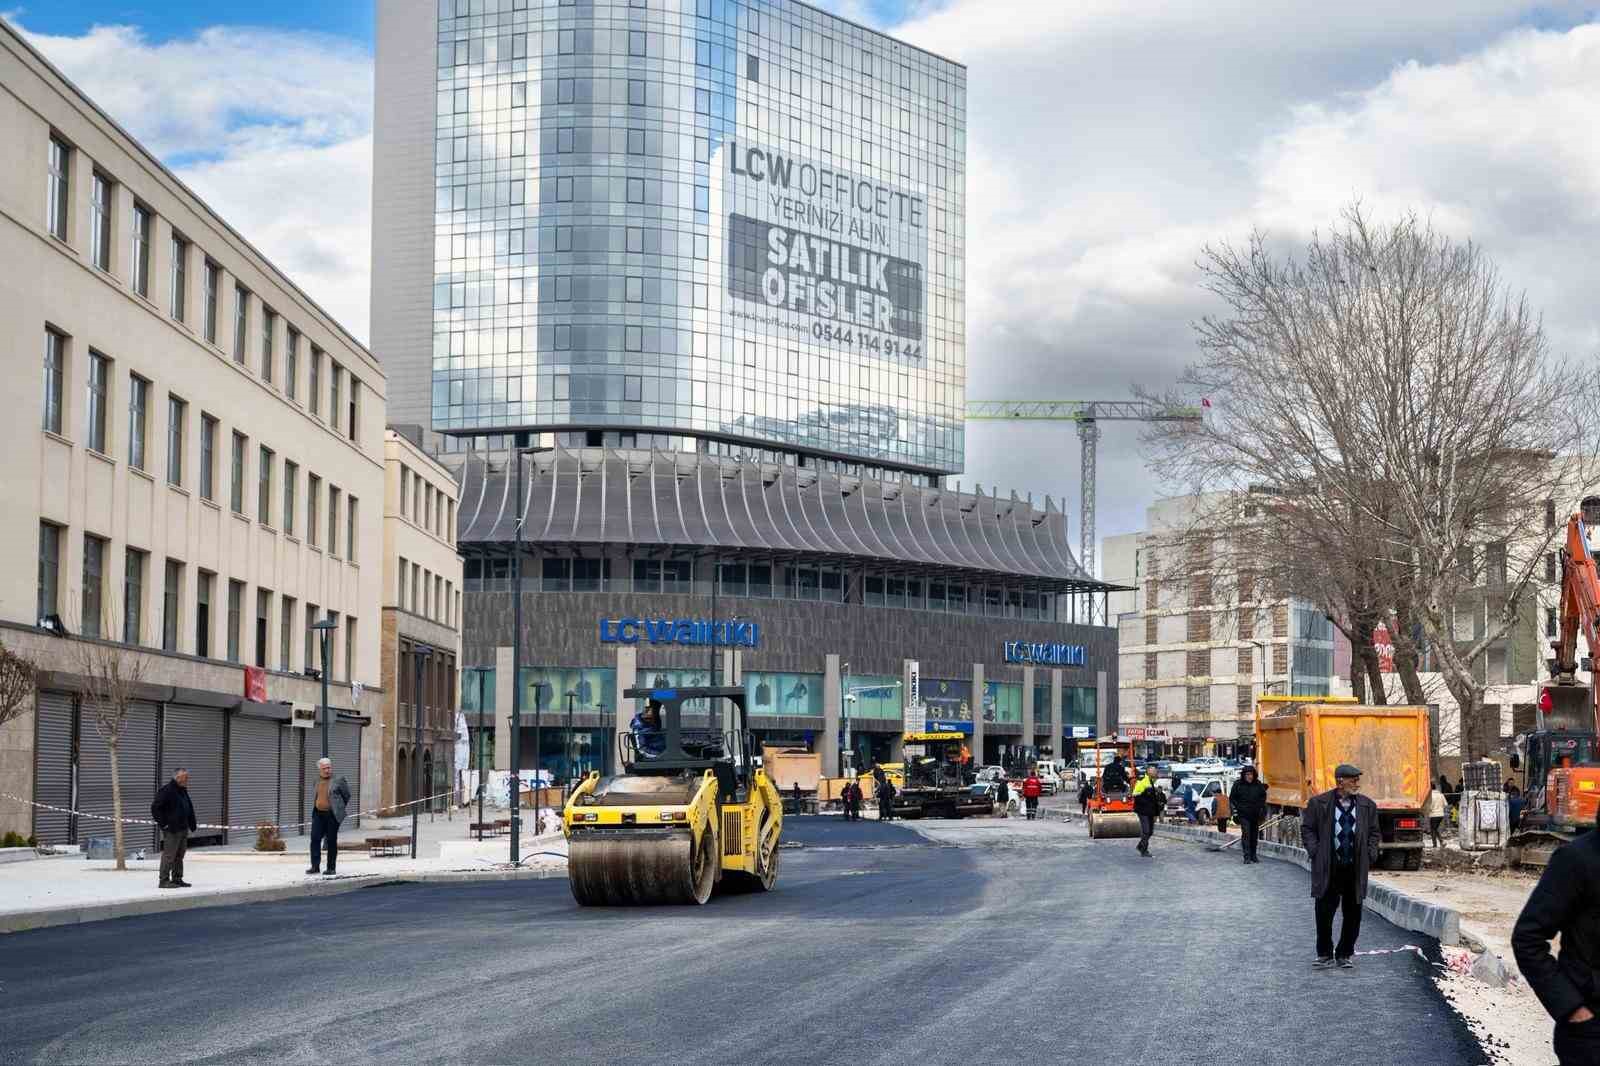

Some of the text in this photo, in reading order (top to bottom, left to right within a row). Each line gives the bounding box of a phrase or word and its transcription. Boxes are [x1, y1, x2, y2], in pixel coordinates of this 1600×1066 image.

[730, 141, 793, 189] LCW
[767, 227, 889, 293] SATILIK
[761, 267, 893, 333] OFİSLER
[812, 321, 854, 345] 0544
[857, 332, 880, 352] 114
[902, 343, 923, 362] 44
[600, 617, 640, 644] LC
